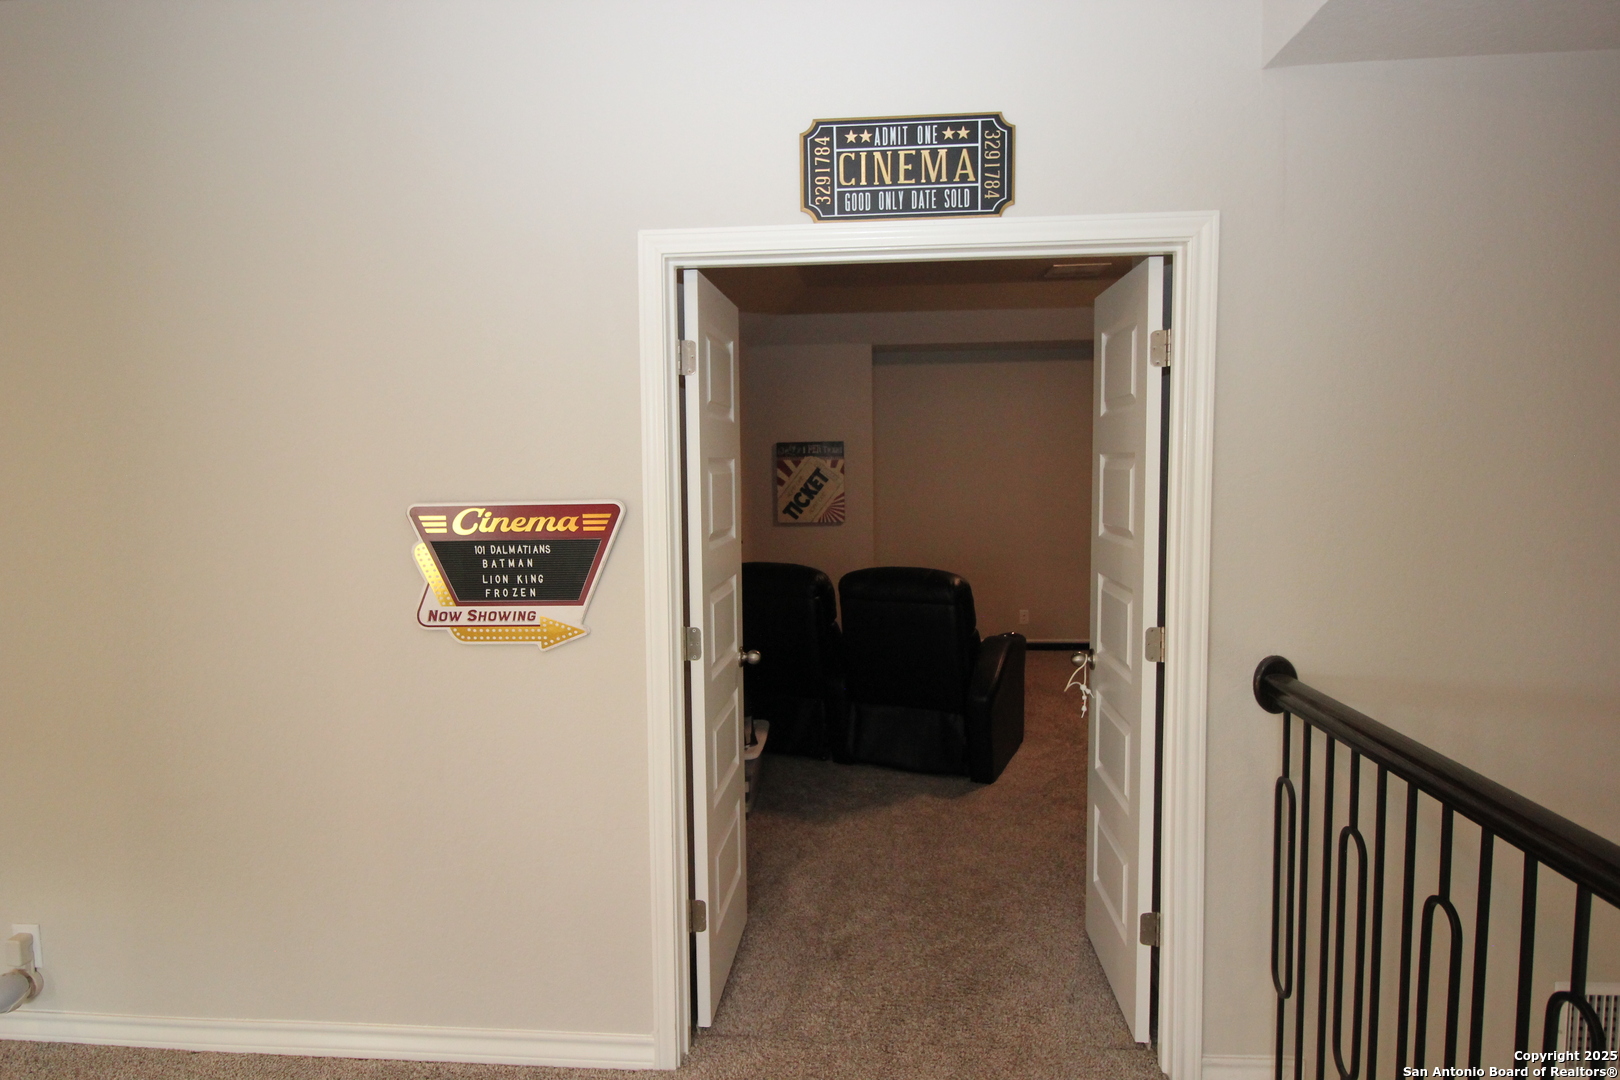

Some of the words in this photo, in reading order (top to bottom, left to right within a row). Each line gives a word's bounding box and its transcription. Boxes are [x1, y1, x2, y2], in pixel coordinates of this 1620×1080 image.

[874, 126, 908, 146] ADMIT
[917, 125, 938, 145] ONE
[814, 136, 831, 205] 3291784
[838, 148, 976, 186] CINEMA
[984, 130, 1000, 199] 3291784
[844, 192, 871, 212] GOOD
[878, 190, 904, 210] ONLY
[911, 189, 937, 209] DATE
[944, 188, 970, 208] SOLD
[782, 467, 829, 520] TICKET
[452, 507, 579, 536] Cinema
[474, 545, 486, 555] 101
[490, 544, 551, 555] DALMATIANS
[482, 558, 533, 569] BATMAN
[482, 574, 509, 584] LION
[517, 574, 544, 584] KING
[485, 588, 536, 598] FROZEN
